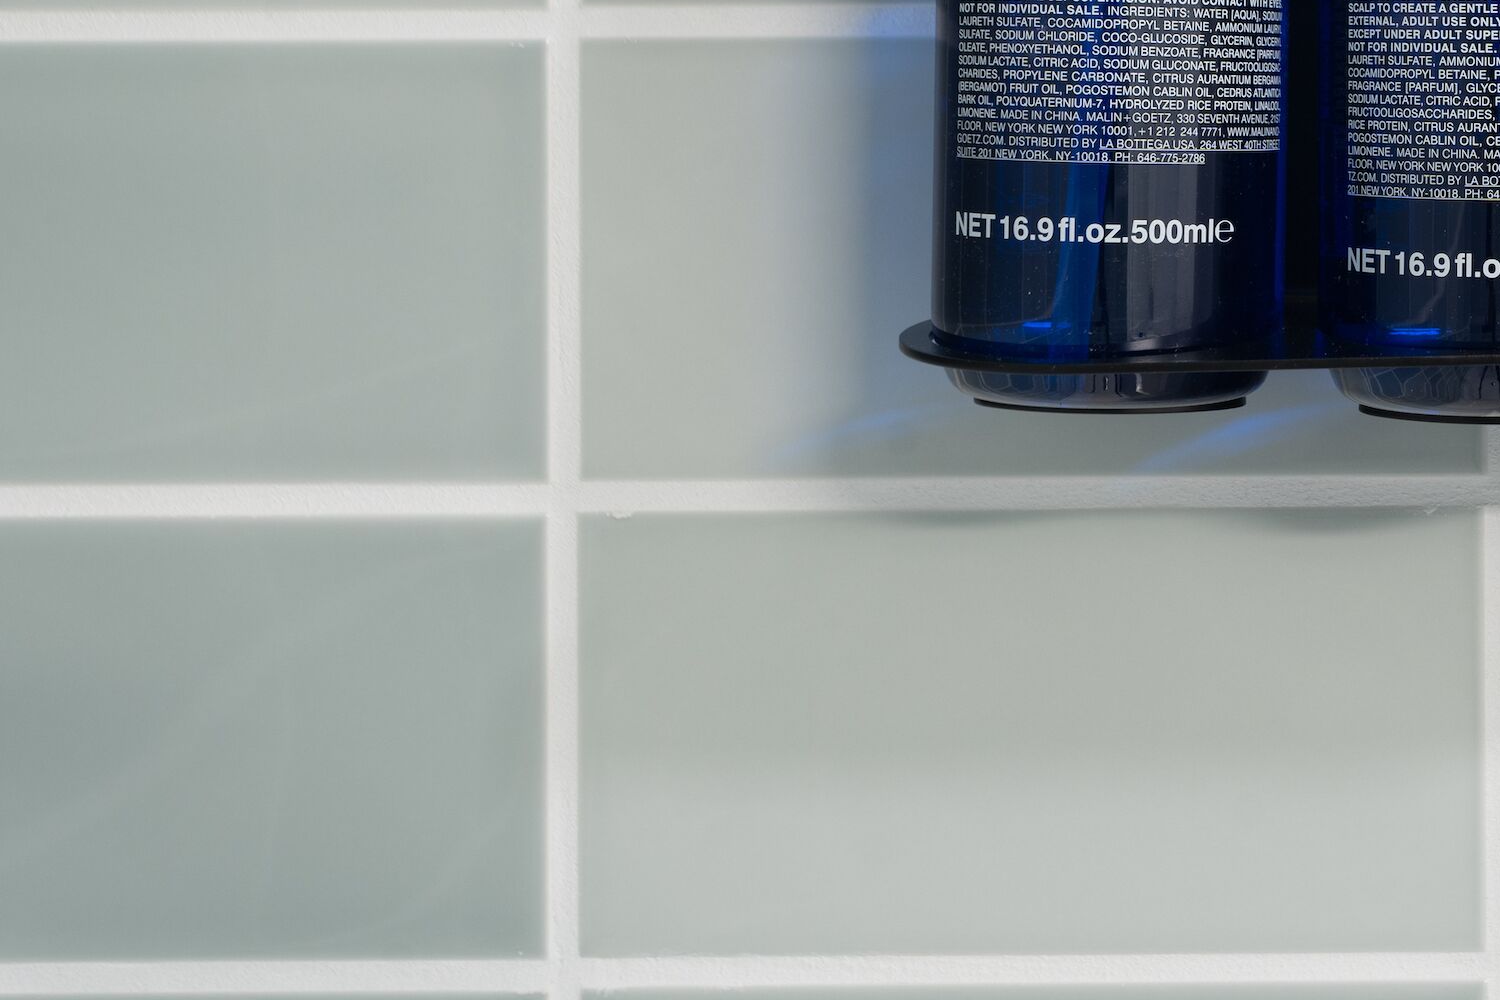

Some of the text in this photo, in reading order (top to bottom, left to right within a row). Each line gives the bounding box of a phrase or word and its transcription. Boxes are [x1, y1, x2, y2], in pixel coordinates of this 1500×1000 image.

[1348, 15, 1398, 28] EXTERNAL,
[1401, 16, 1439, 27] ADULT
[1442, 17, 1467, 27] USE
[958, 81, 1252, 99] (BERGAMOT) FRUIT OIL, POGOSTEMON CABLIN OIL, CEDRUS
[1348, 80, 1401, 92] FRAGRANCE
[1405, 82, 1462, 95] [PARFUM],
[955, 211, 996, 239] NET
[1000, 216, 1053, 242] 16.9
[1347, 246, 1391, 274] NET
[1395, 250, 1450, 278] 16.9
